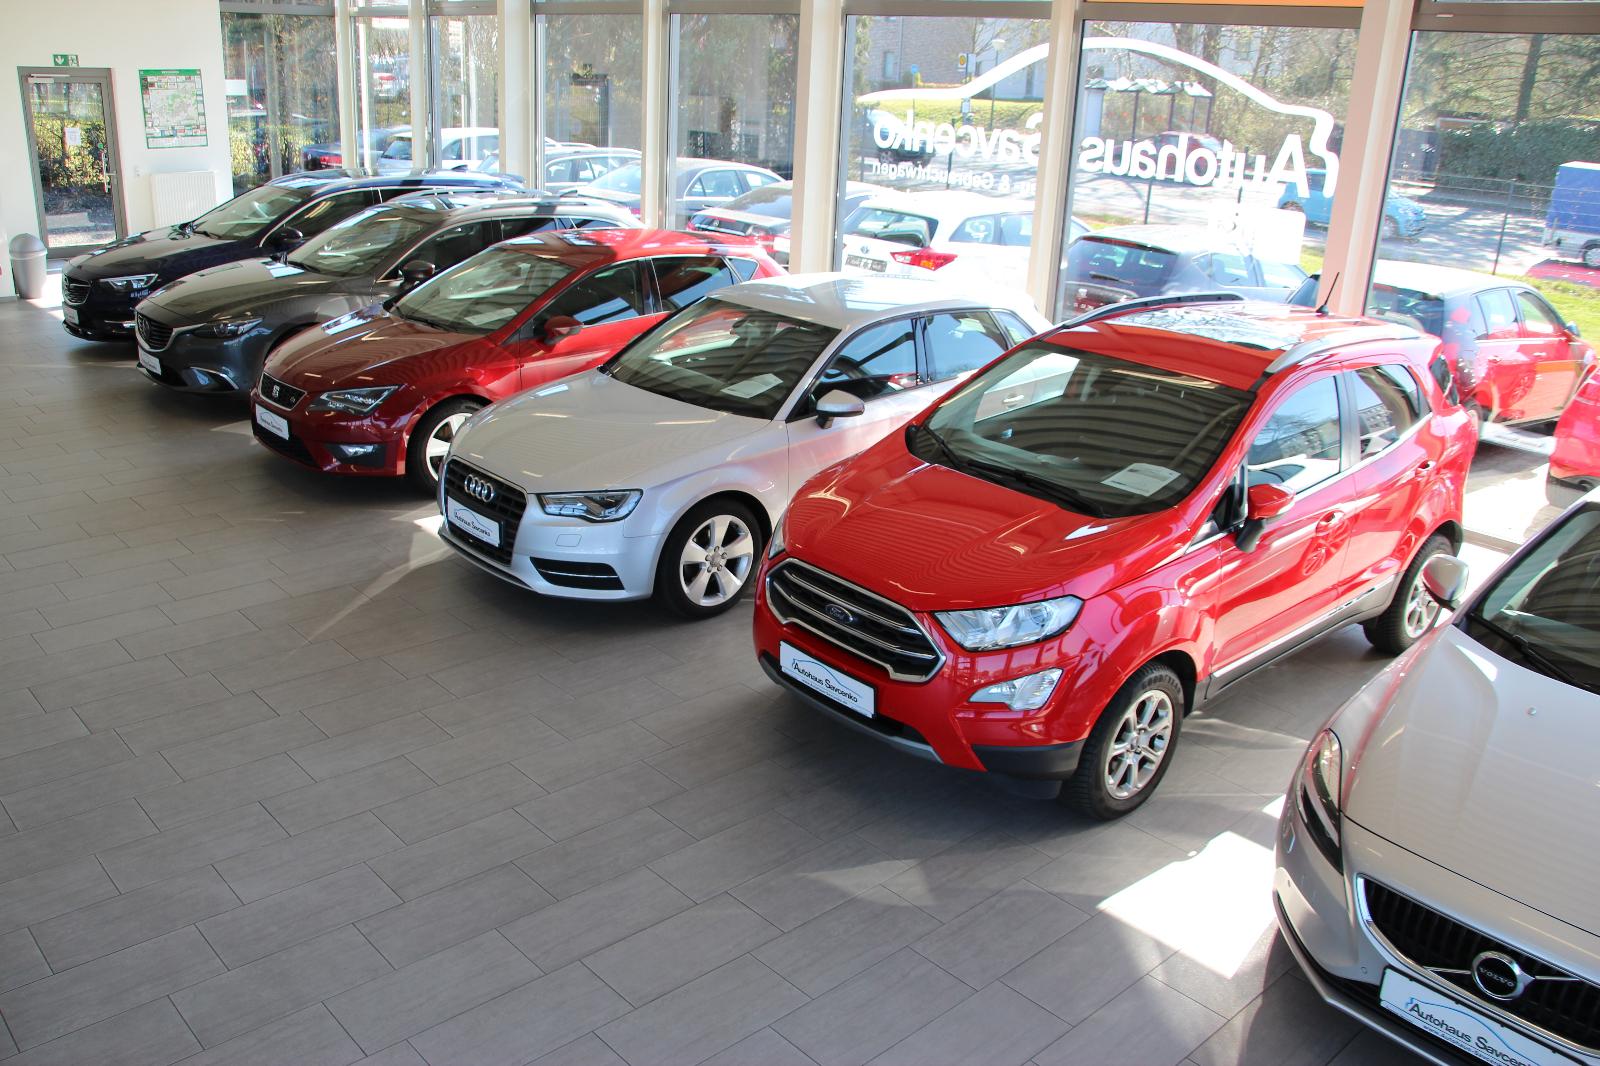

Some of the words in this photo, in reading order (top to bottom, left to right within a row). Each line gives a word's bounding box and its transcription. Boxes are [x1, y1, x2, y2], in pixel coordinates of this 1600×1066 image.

[794, 662, 824, 685] Autohaus
[825, 678, 858, 703] Savcenko
[1479, 967, 1515, 987] VOLVO
[1409, 1003, 1471, 1043] Autohaus
[1475, 1036, 1531, 1066] Savcen
